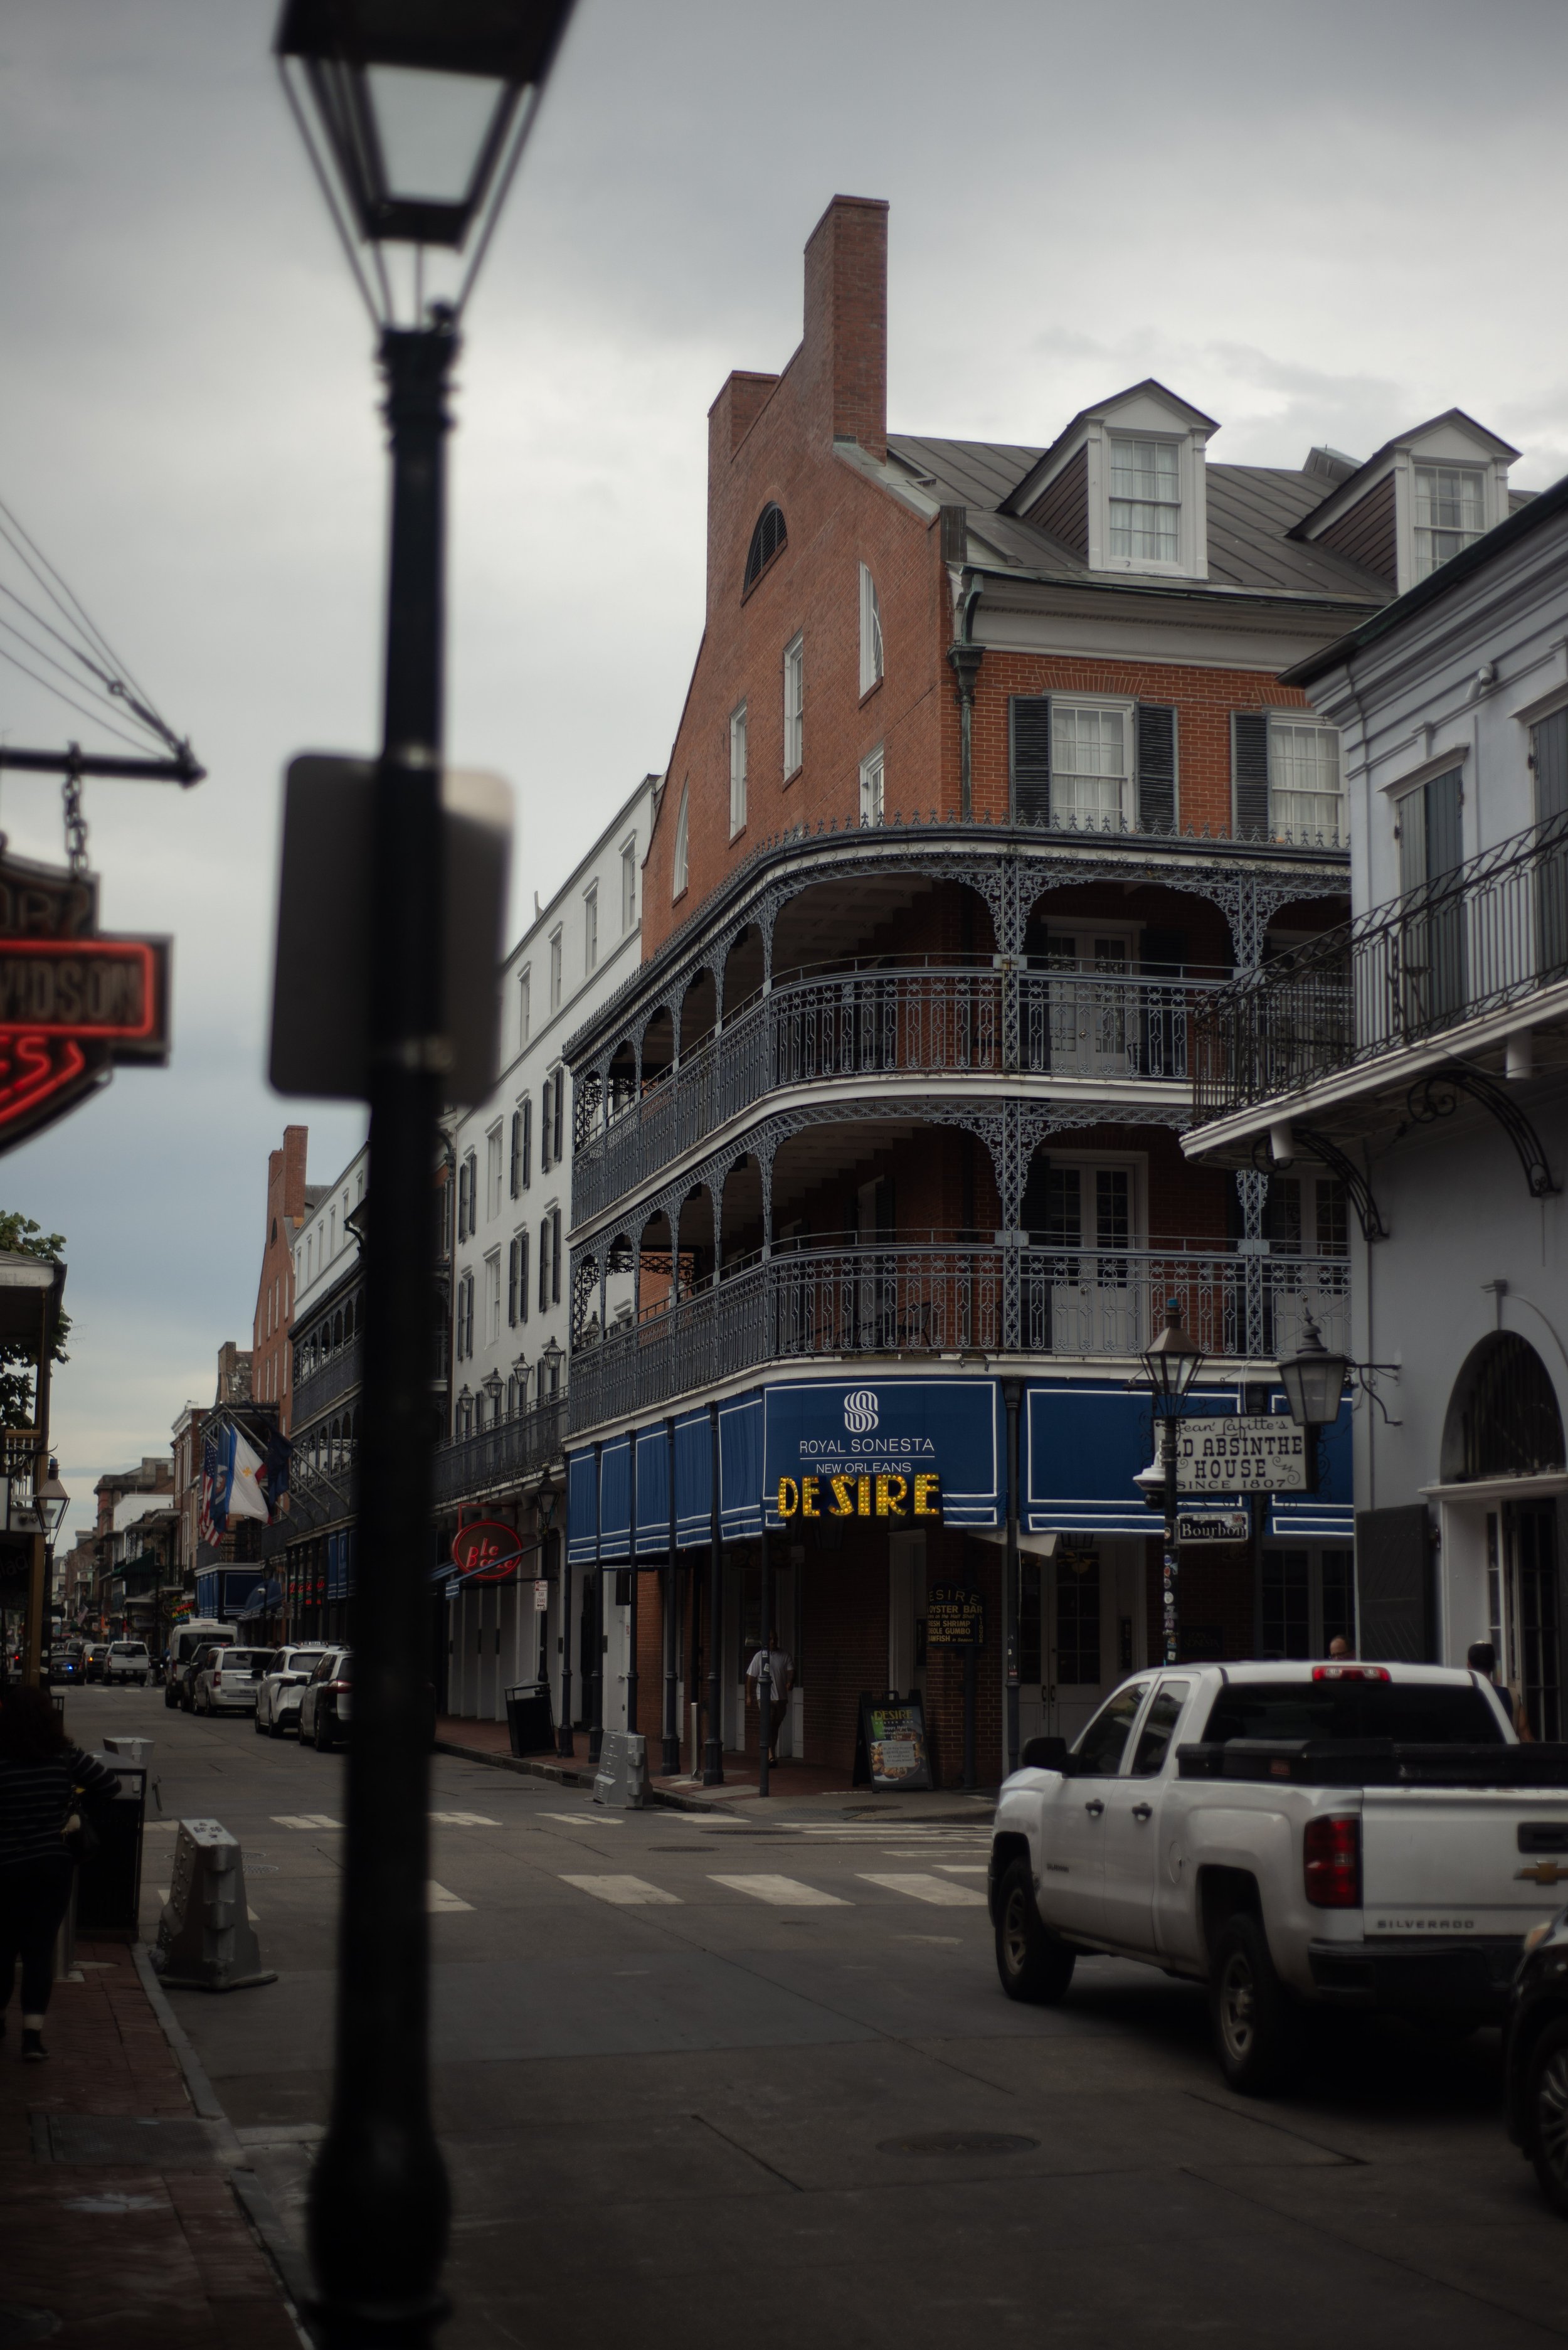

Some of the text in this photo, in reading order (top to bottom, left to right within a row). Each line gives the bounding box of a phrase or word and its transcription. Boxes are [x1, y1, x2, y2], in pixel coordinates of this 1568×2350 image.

[1216, 1418, 1288, 1441] Lafitte's
[800, 1438, 935, 1454] ROYAL SONESTA
[1203, 1436, 1302, 1457] ABSINTHE
[816, 1462, 912, 1474] NEW ORLEANS
[1195, 1459, 1266, 1479] HOUSE
[1176, 1479, 1286, 1490] SINCE 1807
[778, 1473, 940, 1517] DESIRE
[1182, 1523, 1244, 1537] Bourbon
[928, 1589, 980, 1606] ESIRE
[929, 1605, 983, 1614] OYSTER BAR
[874, 1709, 914, 1721] DESIRE
[1377, 1920, 1475, 1929] SILVERADO
